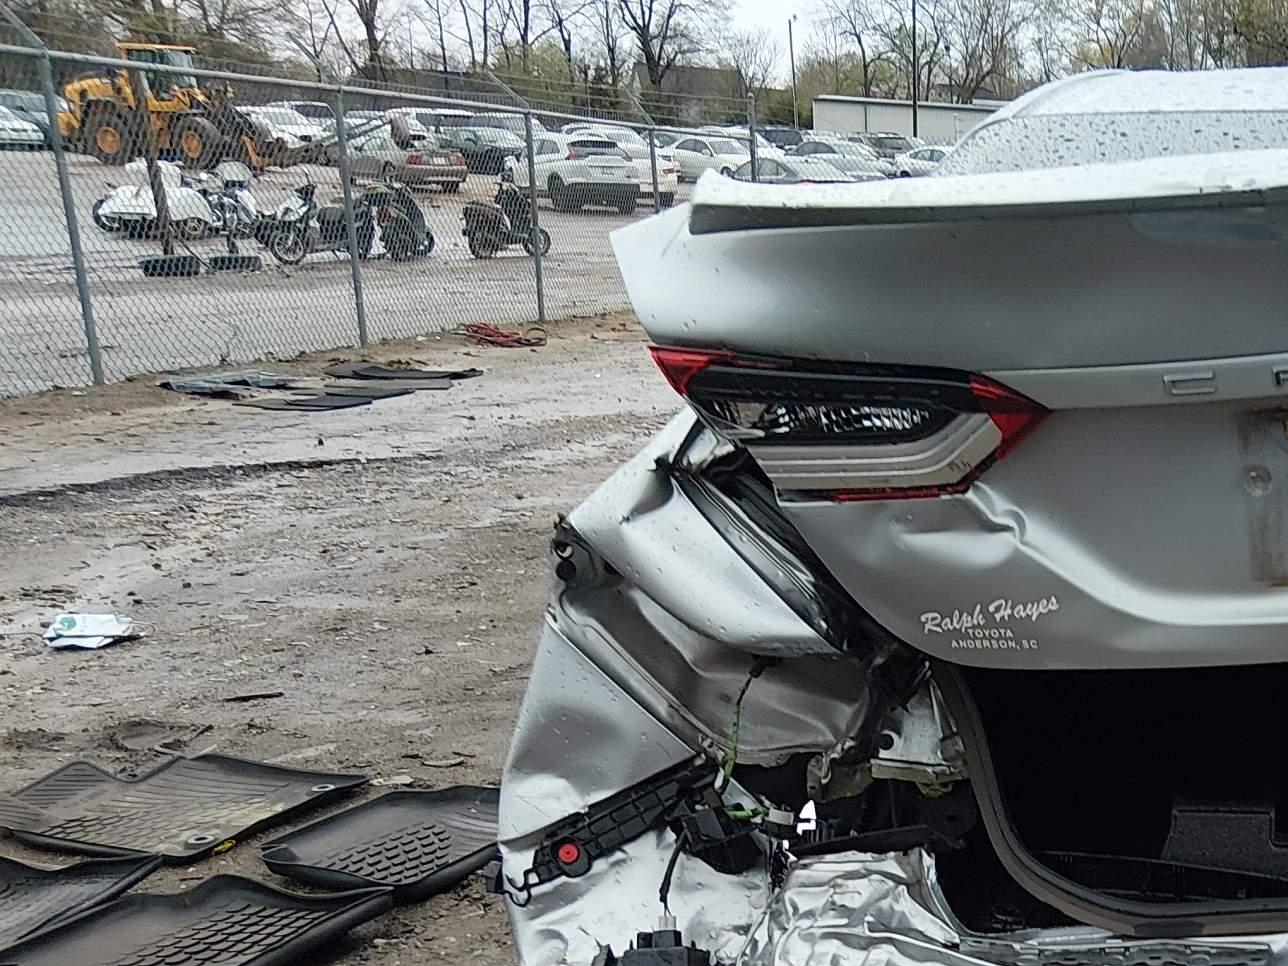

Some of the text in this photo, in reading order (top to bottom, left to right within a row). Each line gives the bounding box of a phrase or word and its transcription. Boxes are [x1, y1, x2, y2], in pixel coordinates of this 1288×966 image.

[920, 595, 1060, 635] Ralph Hayes
[967, 628, 1014, 638] TOYOTA
[951, 639, 1038, 650] ANDERSON, SC
